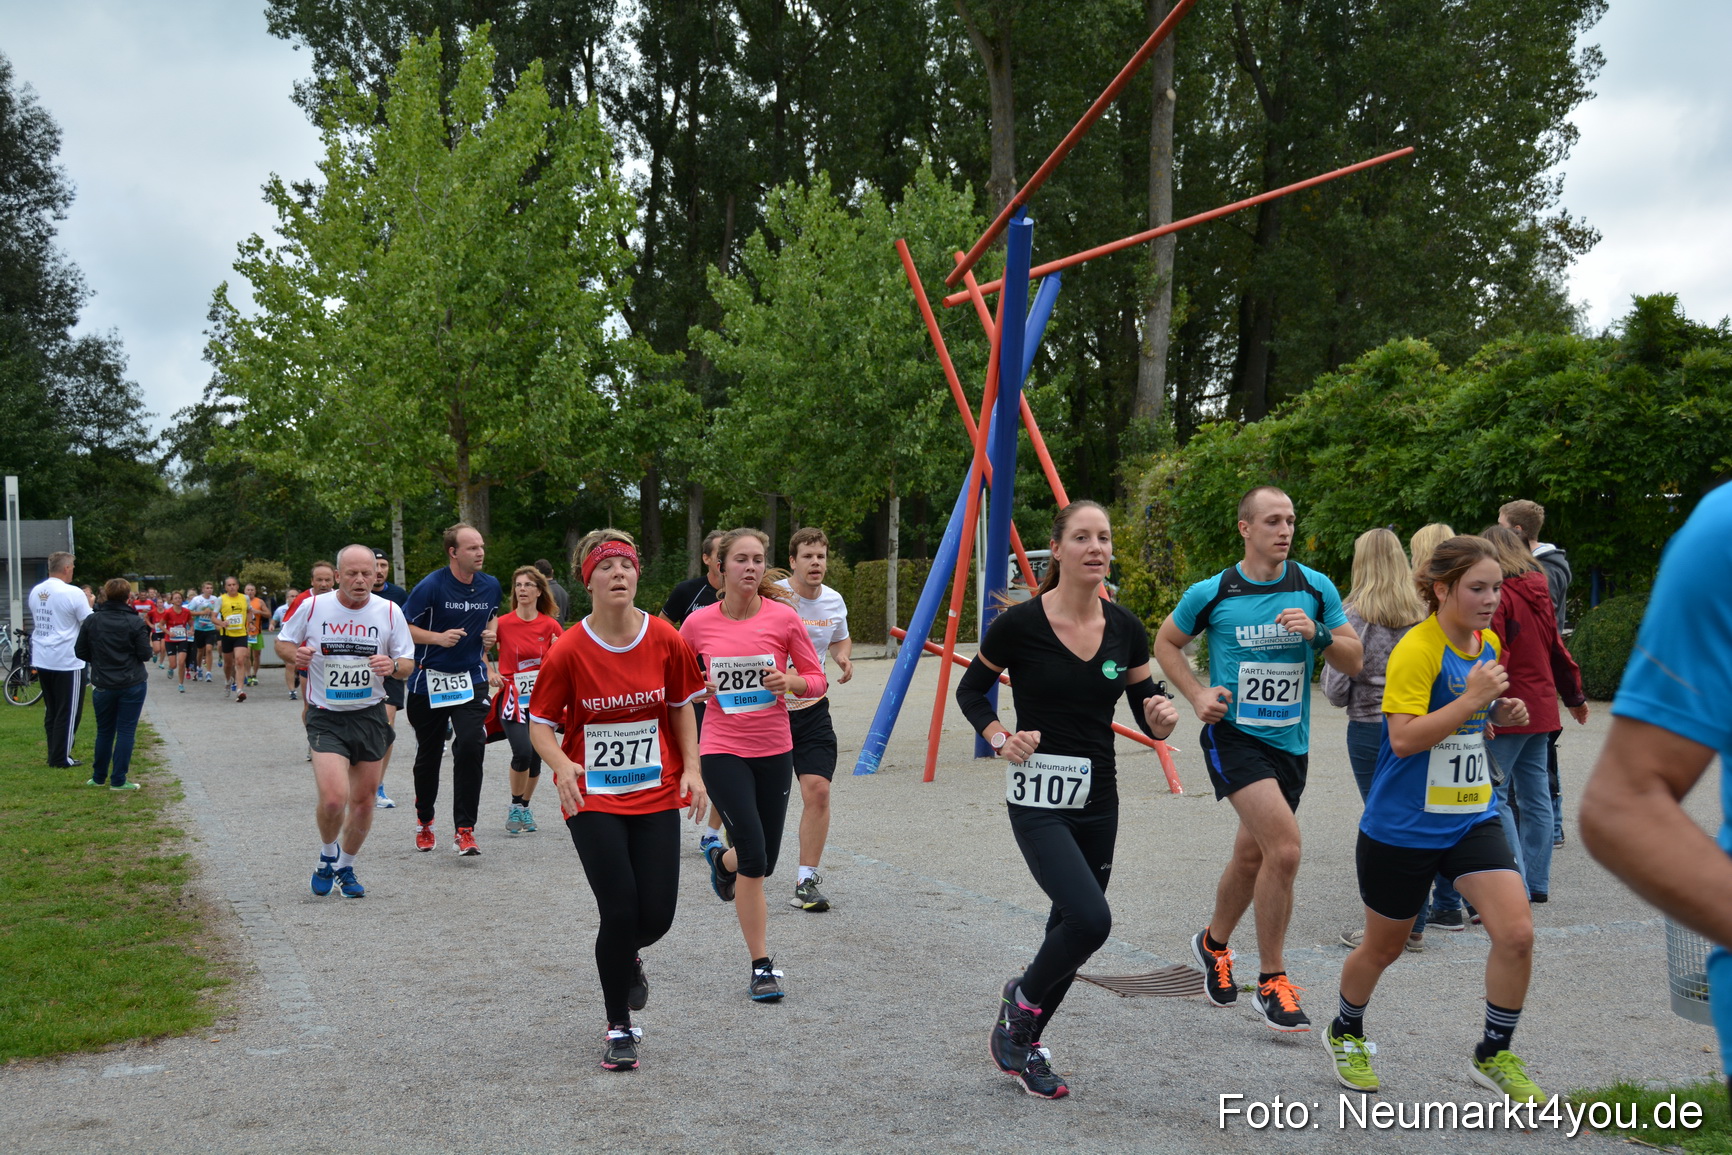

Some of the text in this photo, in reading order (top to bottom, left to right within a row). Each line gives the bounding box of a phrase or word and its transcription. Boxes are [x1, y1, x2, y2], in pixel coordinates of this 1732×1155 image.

[321, 619, 379, 638] twinn
[1251, 637, 1300, 645] TECHNOLOGY
[329, 669, 371, 688] 2449
[432, 675, 468, 692] 2155
[520, 680, 535, 695] 25
[1246, 678, 1300, 702] 2621
[335, 691, 364, 699] Willfried
[441, 693, 463, 701] Marcus
[734, 695, 758, 705] Elena
[1257, 707, 1289, 718] Marcin
[614, 729, 647, 737] Neumarkt
[594, 737, 653, 767] 2377
[1433, 743, 1462, 751] PARTL
[1036, 762, 1076, 773] Neumarkt
[1449, 753, 1483, 783] 102
[604, 772, 646, 784] Karoline
[1013, 771, 1083, 806] 3107
[1457, 791, 1479, 803] Lena
